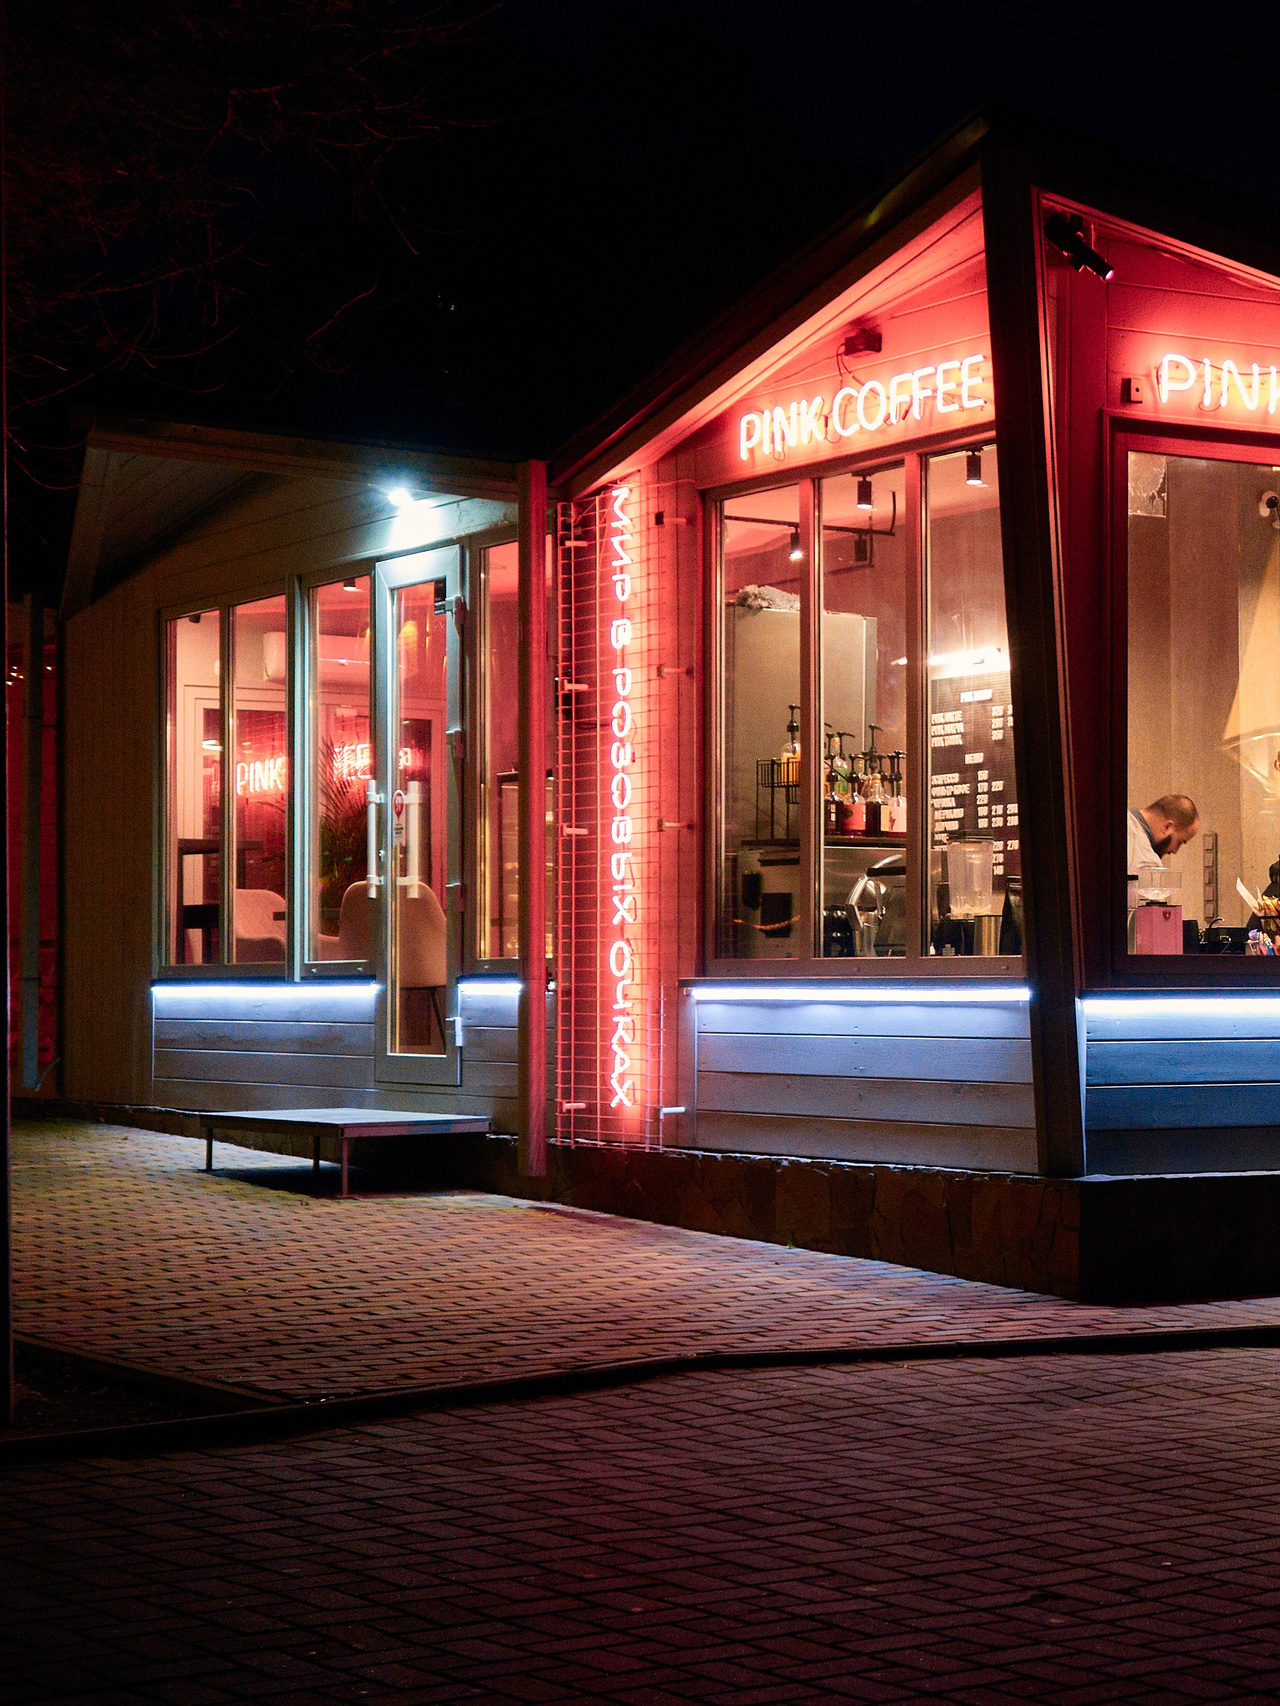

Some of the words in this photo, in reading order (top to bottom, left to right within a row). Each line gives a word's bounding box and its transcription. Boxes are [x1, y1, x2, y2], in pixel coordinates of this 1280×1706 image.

[739, 395, 825, 461] PINK
[832, 353, 987, 437] COFFEE
[611, 487, 631, 602] МИР
[611, 618, 631, 649] В
[237, 758, 282, 795] PINK
[610, 667, 632, 926] РОЗОВЫХ
[609, 939, 632, 1109] ОЧКАХ
